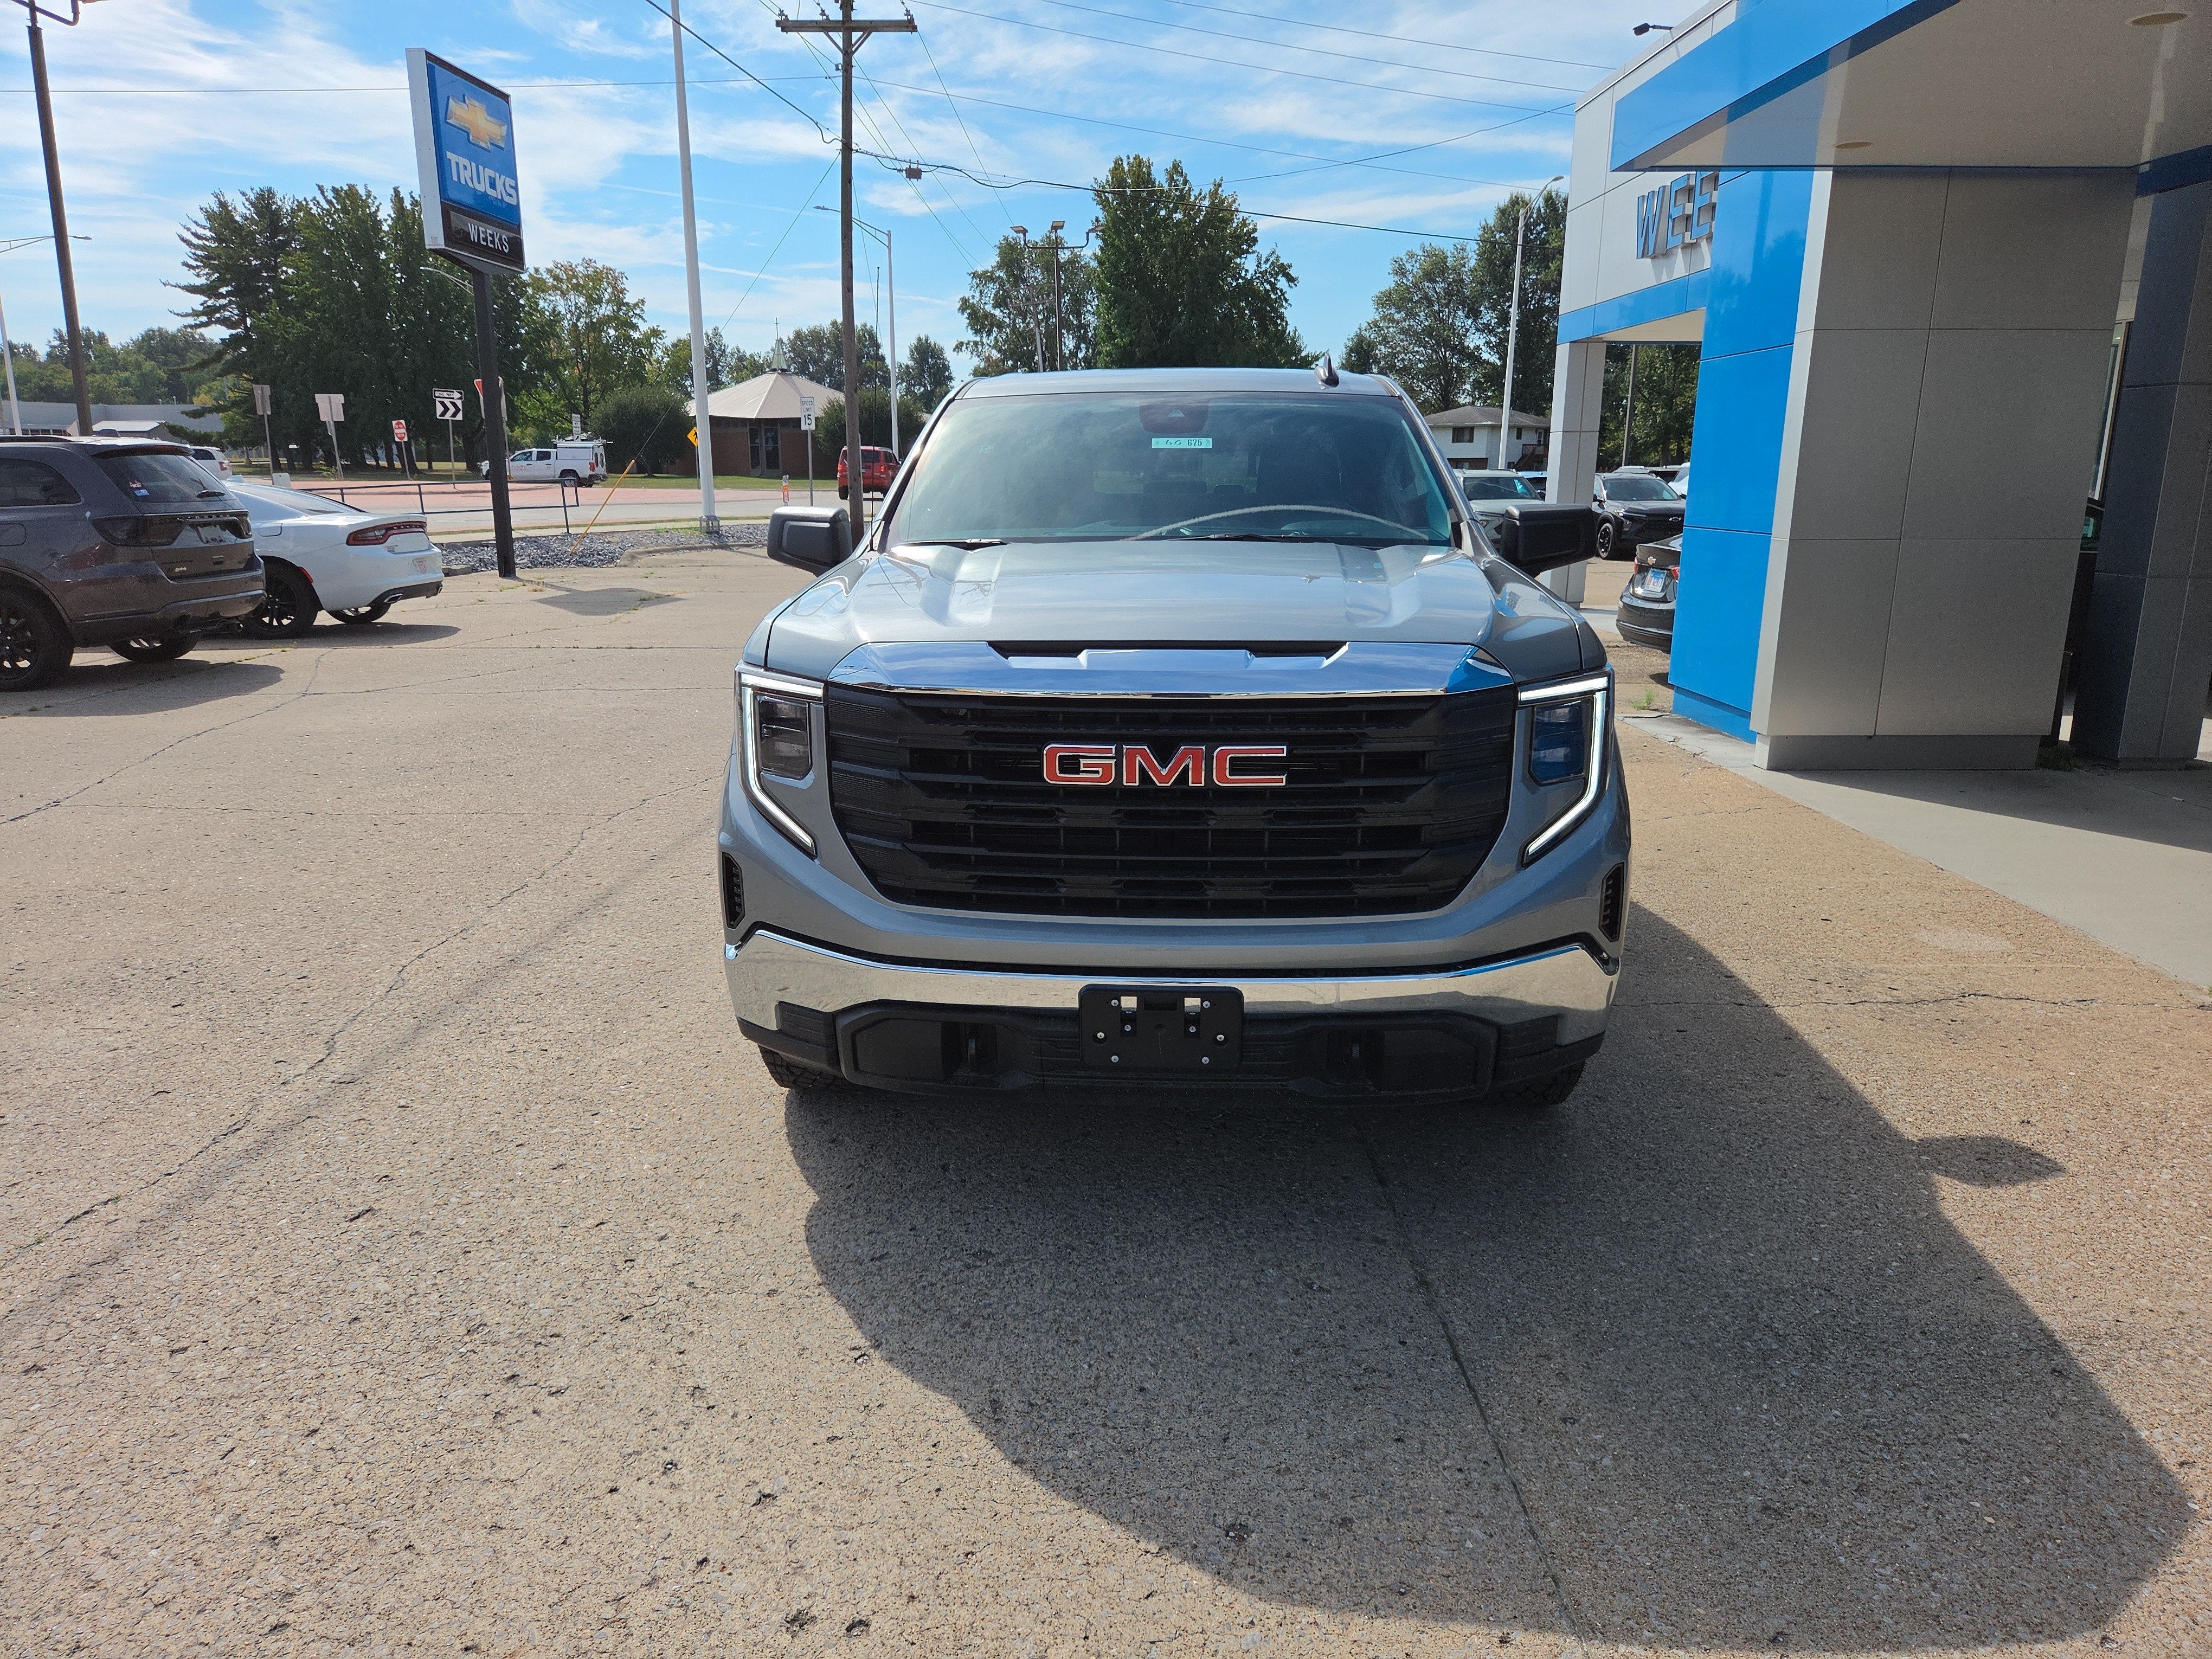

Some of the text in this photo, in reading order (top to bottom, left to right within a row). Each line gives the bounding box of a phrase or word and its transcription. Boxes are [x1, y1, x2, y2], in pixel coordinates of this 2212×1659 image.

[446, 151, 517, 205] TRUCKS
[468, 222, 509, 254] WEEKS
[803, 414, 812, 426] 15
[1043, 743, 1288, 787] GMC
